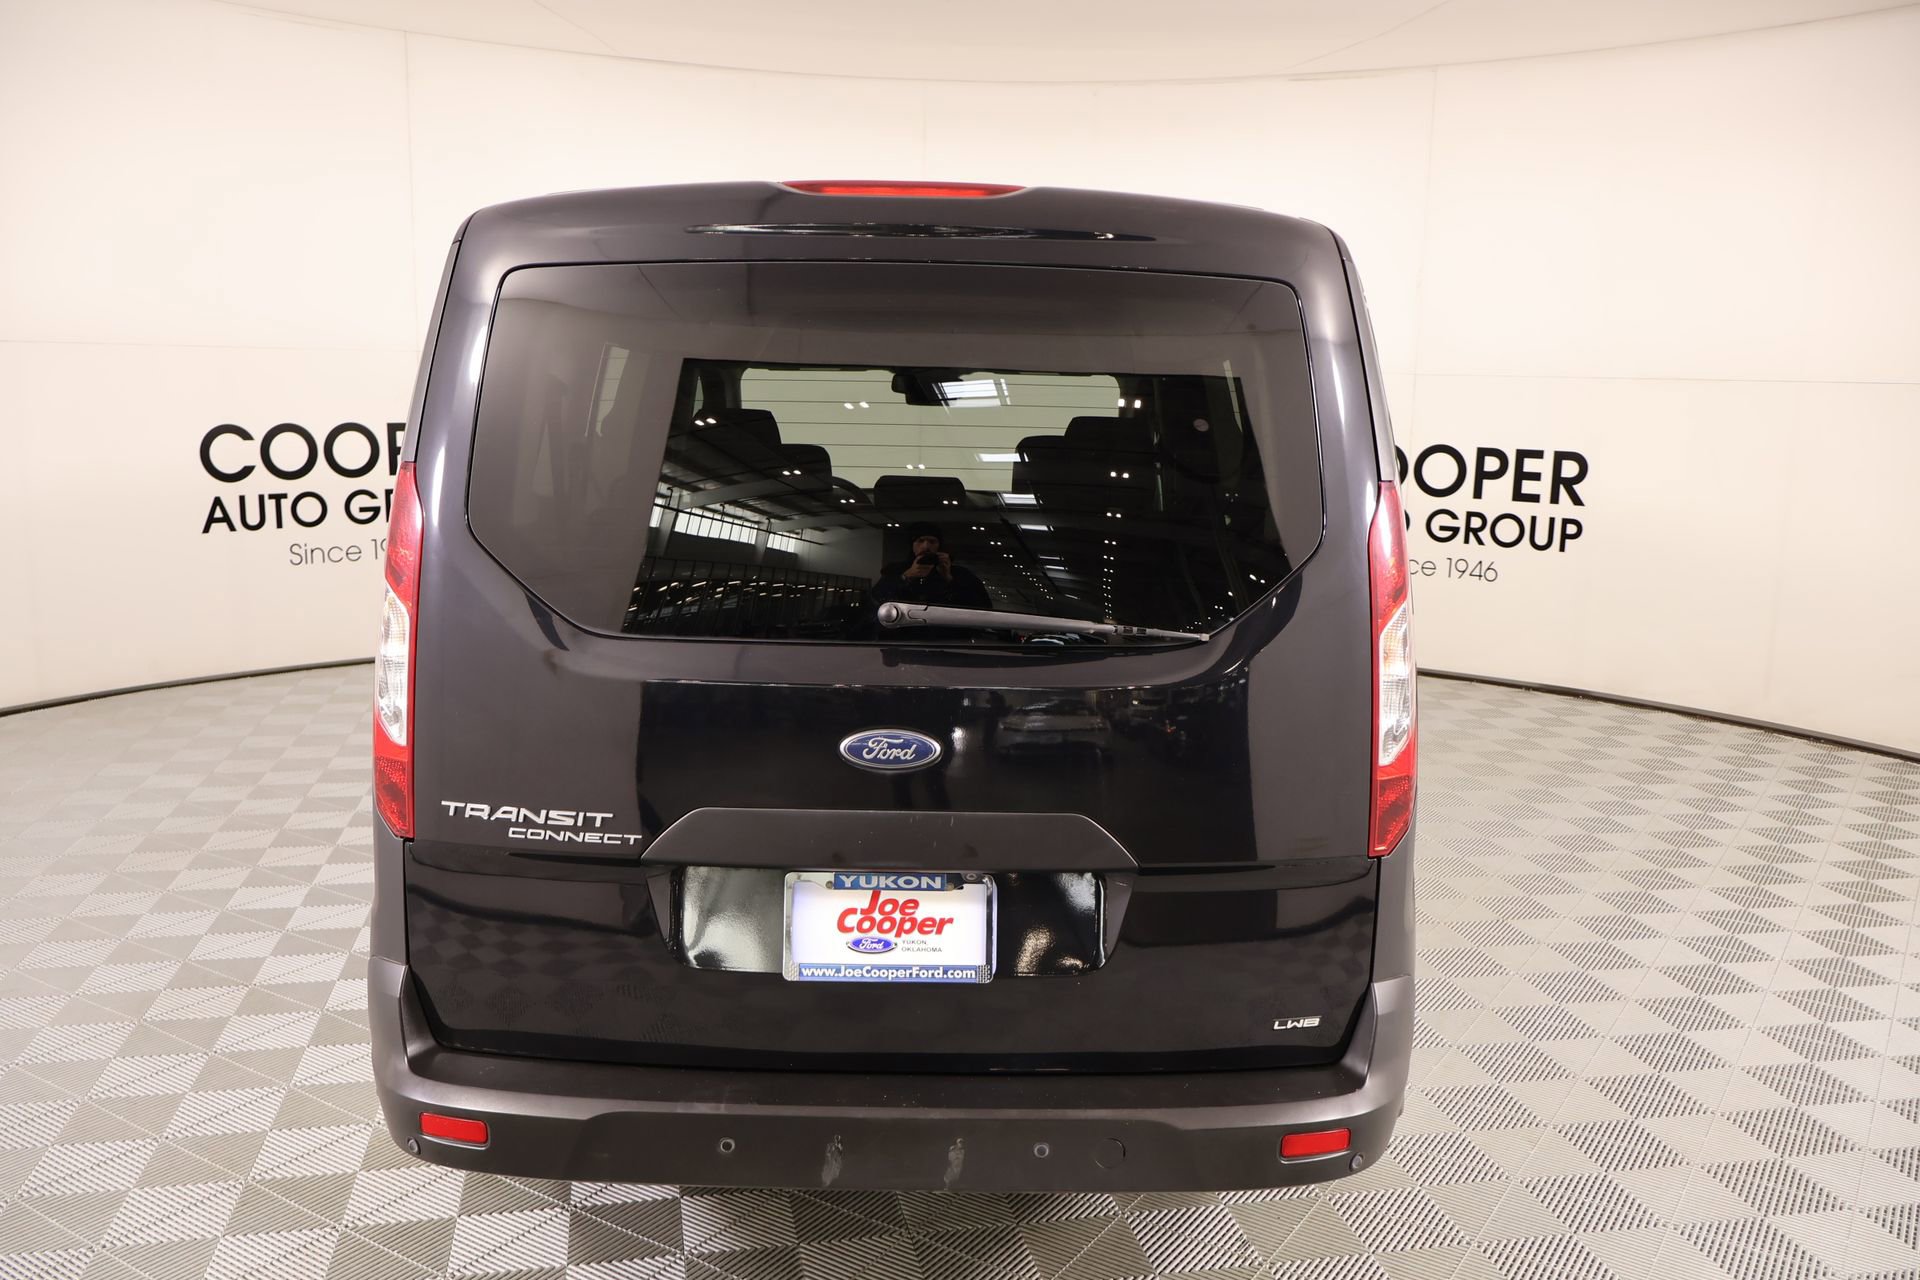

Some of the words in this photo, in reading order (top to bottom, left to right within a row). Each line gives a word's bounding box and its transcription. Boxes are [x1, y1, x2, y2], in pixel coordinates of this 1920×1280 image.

[201, 491, 327, 534] AUTO
[1425, 508, 1583, 553] GROUP
[289, 543, 362, 566] Since
[1446, 557, 1498, 583] 1946
[862, 737, 917, 760] Ford
[441, 800, 614, 828] TRANSIT
[508, 827, 643, 845] CONNECT
[839, 875, 942, 889] YUKON
[860, 890, 919, 916] Joe
[837, 907, 954, 938] Cooper
[859, 937, 885, 950] Ford
[802, 964, 976, 980] www.JoeCooperFord.com
[1273, 1018, 1320, 1030] LWB
